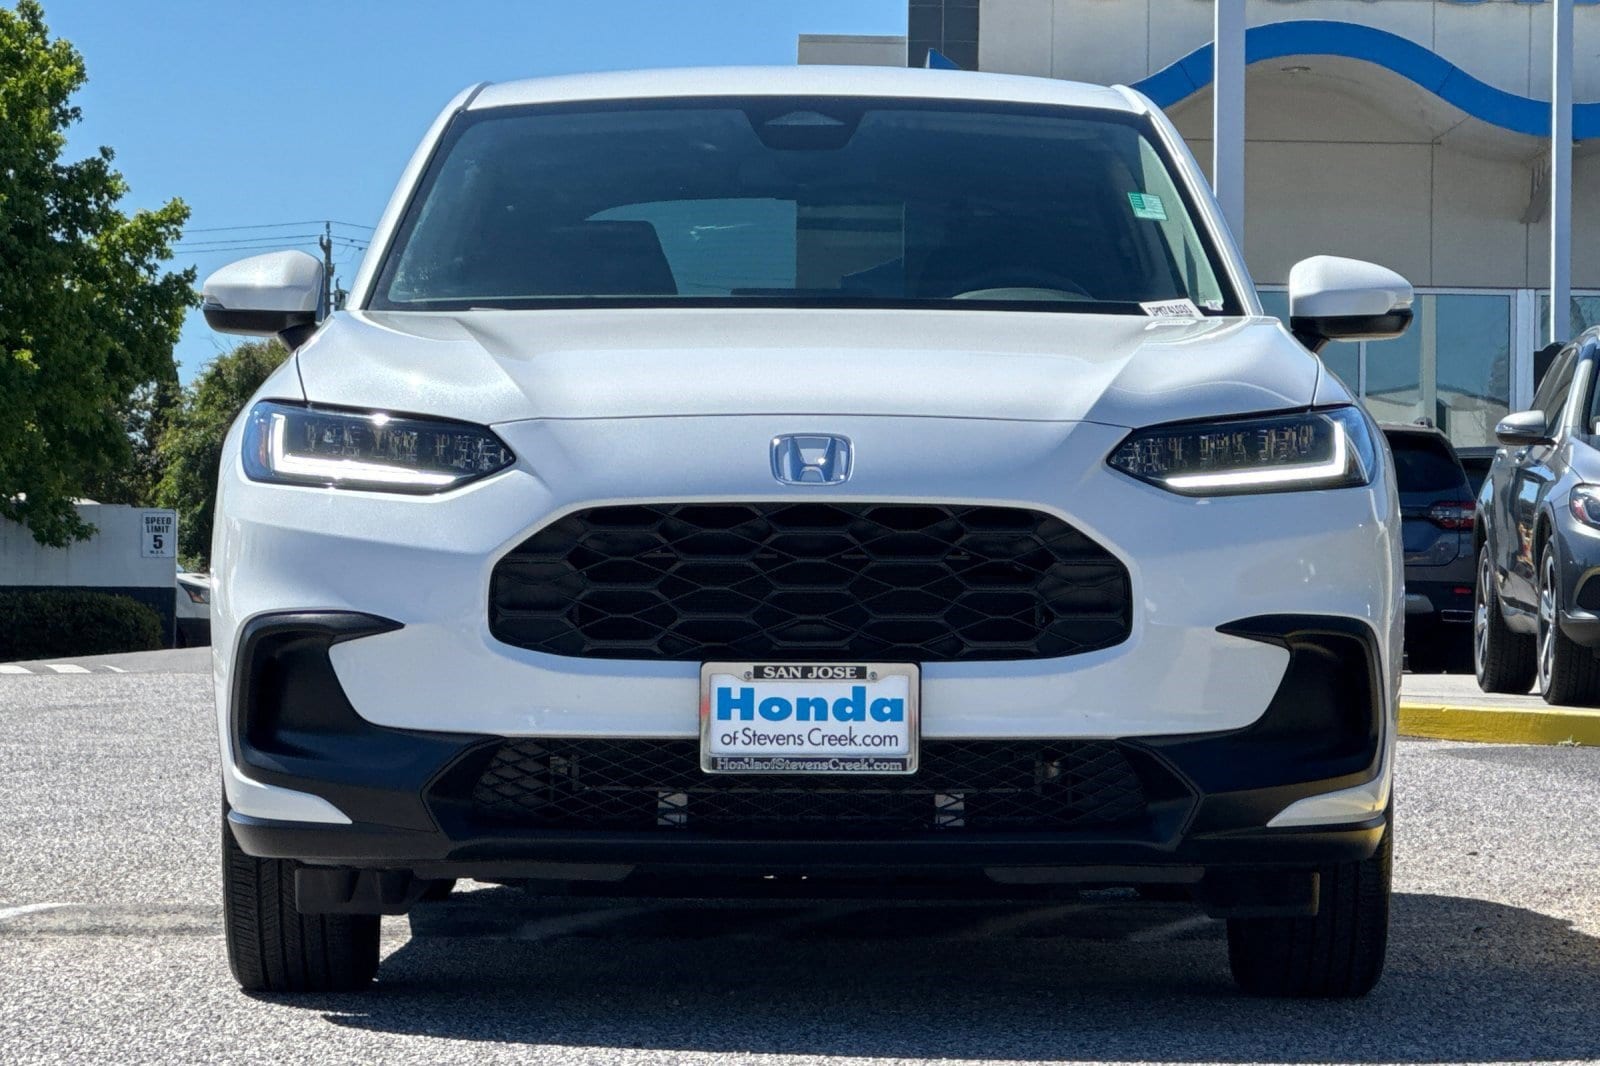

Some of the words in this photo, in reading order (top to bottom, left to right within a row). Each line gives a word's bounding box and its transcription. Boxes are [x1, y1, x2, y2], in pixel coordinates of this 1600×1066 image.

[144, 516, 172, 525] SPEED
[146, 525, 170, 534] LIMIT
[153, 534, 163, 549] 5
[763, 666, 803, 679] SAN
[807, 666, 857, 680] JOSE
[716, 685, 905, 723] Honda
[720, 730, 740, 746] of
[741, 726, 804, 747] Stevens
[807, 725, 899, 747] Creek.com
